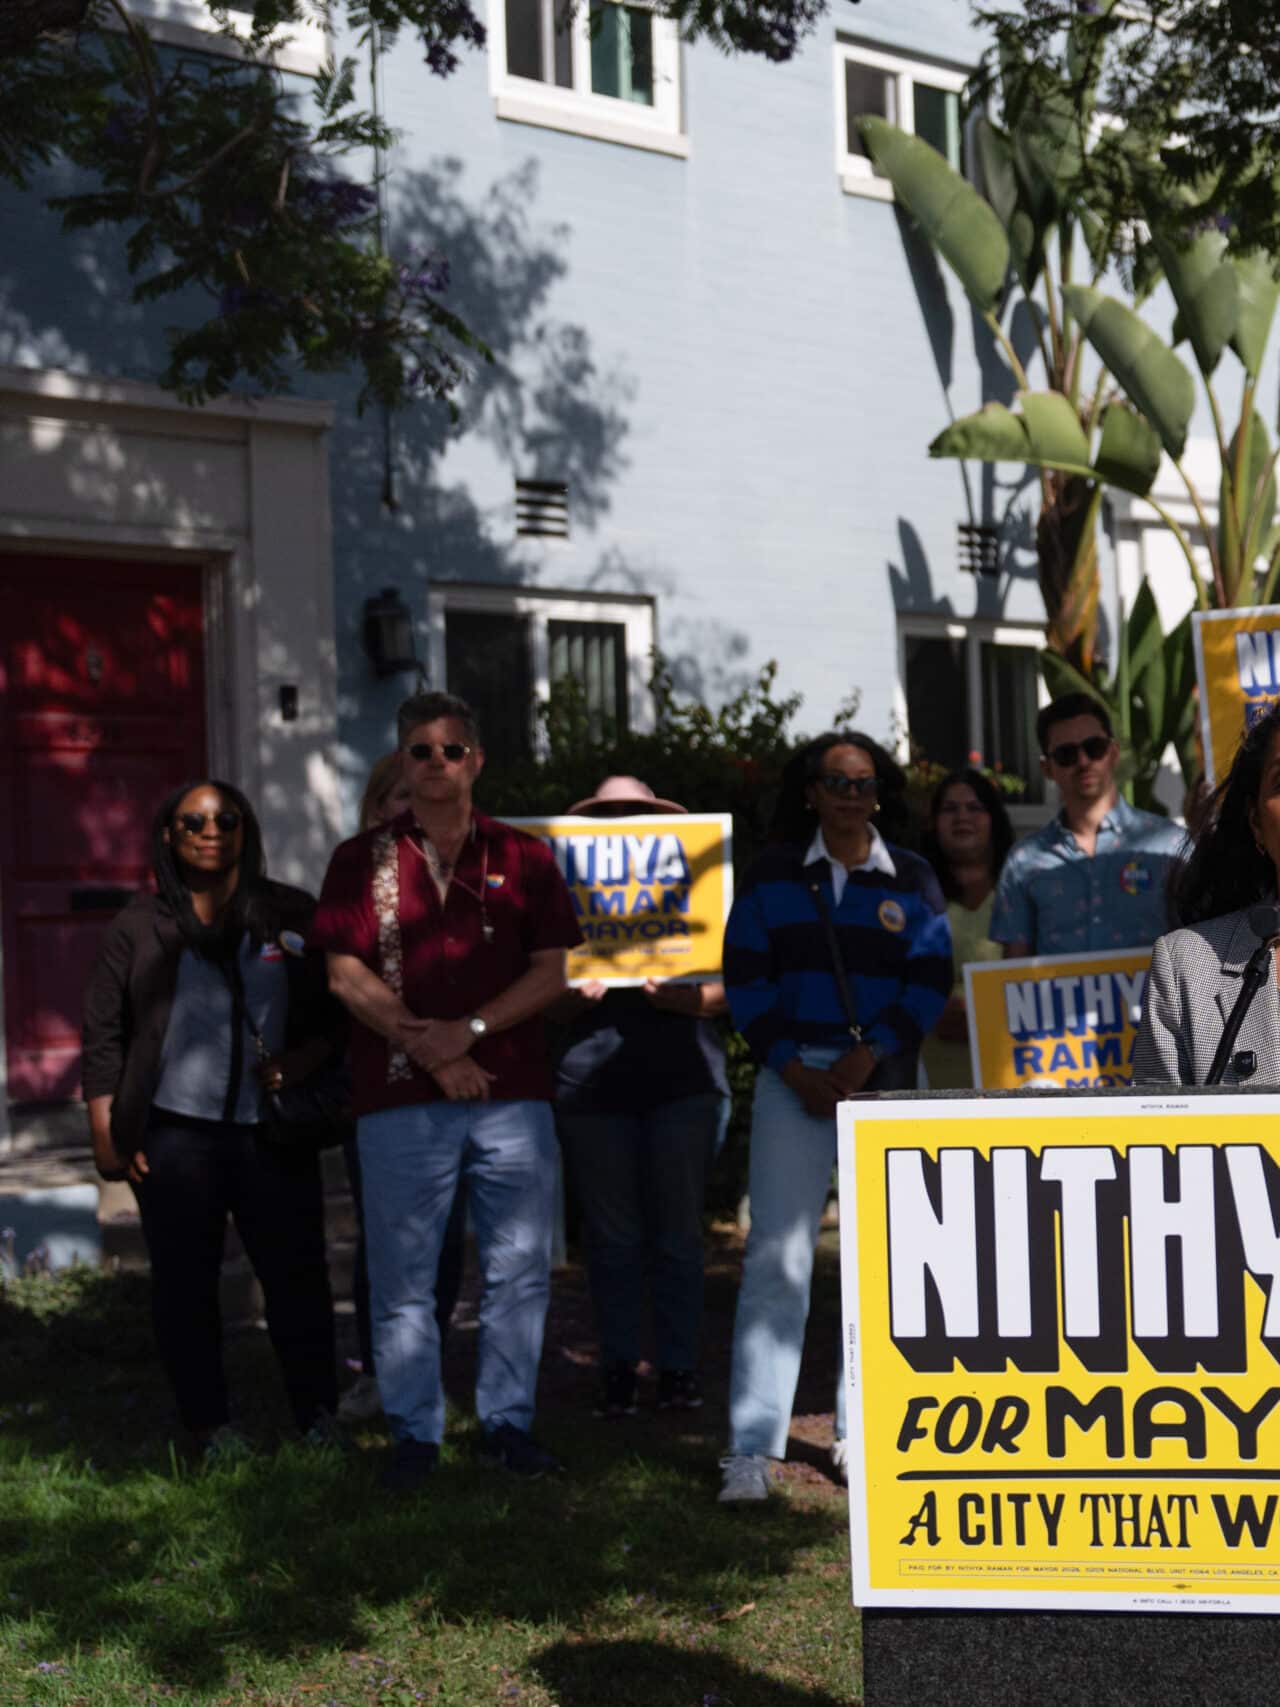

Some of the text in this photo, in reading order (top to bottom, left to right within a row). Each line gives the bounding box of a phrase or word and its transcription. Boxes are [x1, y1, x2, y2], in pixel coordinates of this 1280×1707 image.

[549, 834, 691, 886] ITHYA
[568, 890, 690, 916] MAN
[1004, 970, 1151, 1042] NITHY
[1012, 1036, 1137, 1075] RAM
[1065, 1073, 1133, 1088] MAY
[897, 1395, 1030, 1455] FOR
[899, 1490, 940, 1547] A
[958, 1491, 1063, 1547] CITY
[1080, 1493, 1198, 1549] THAT
